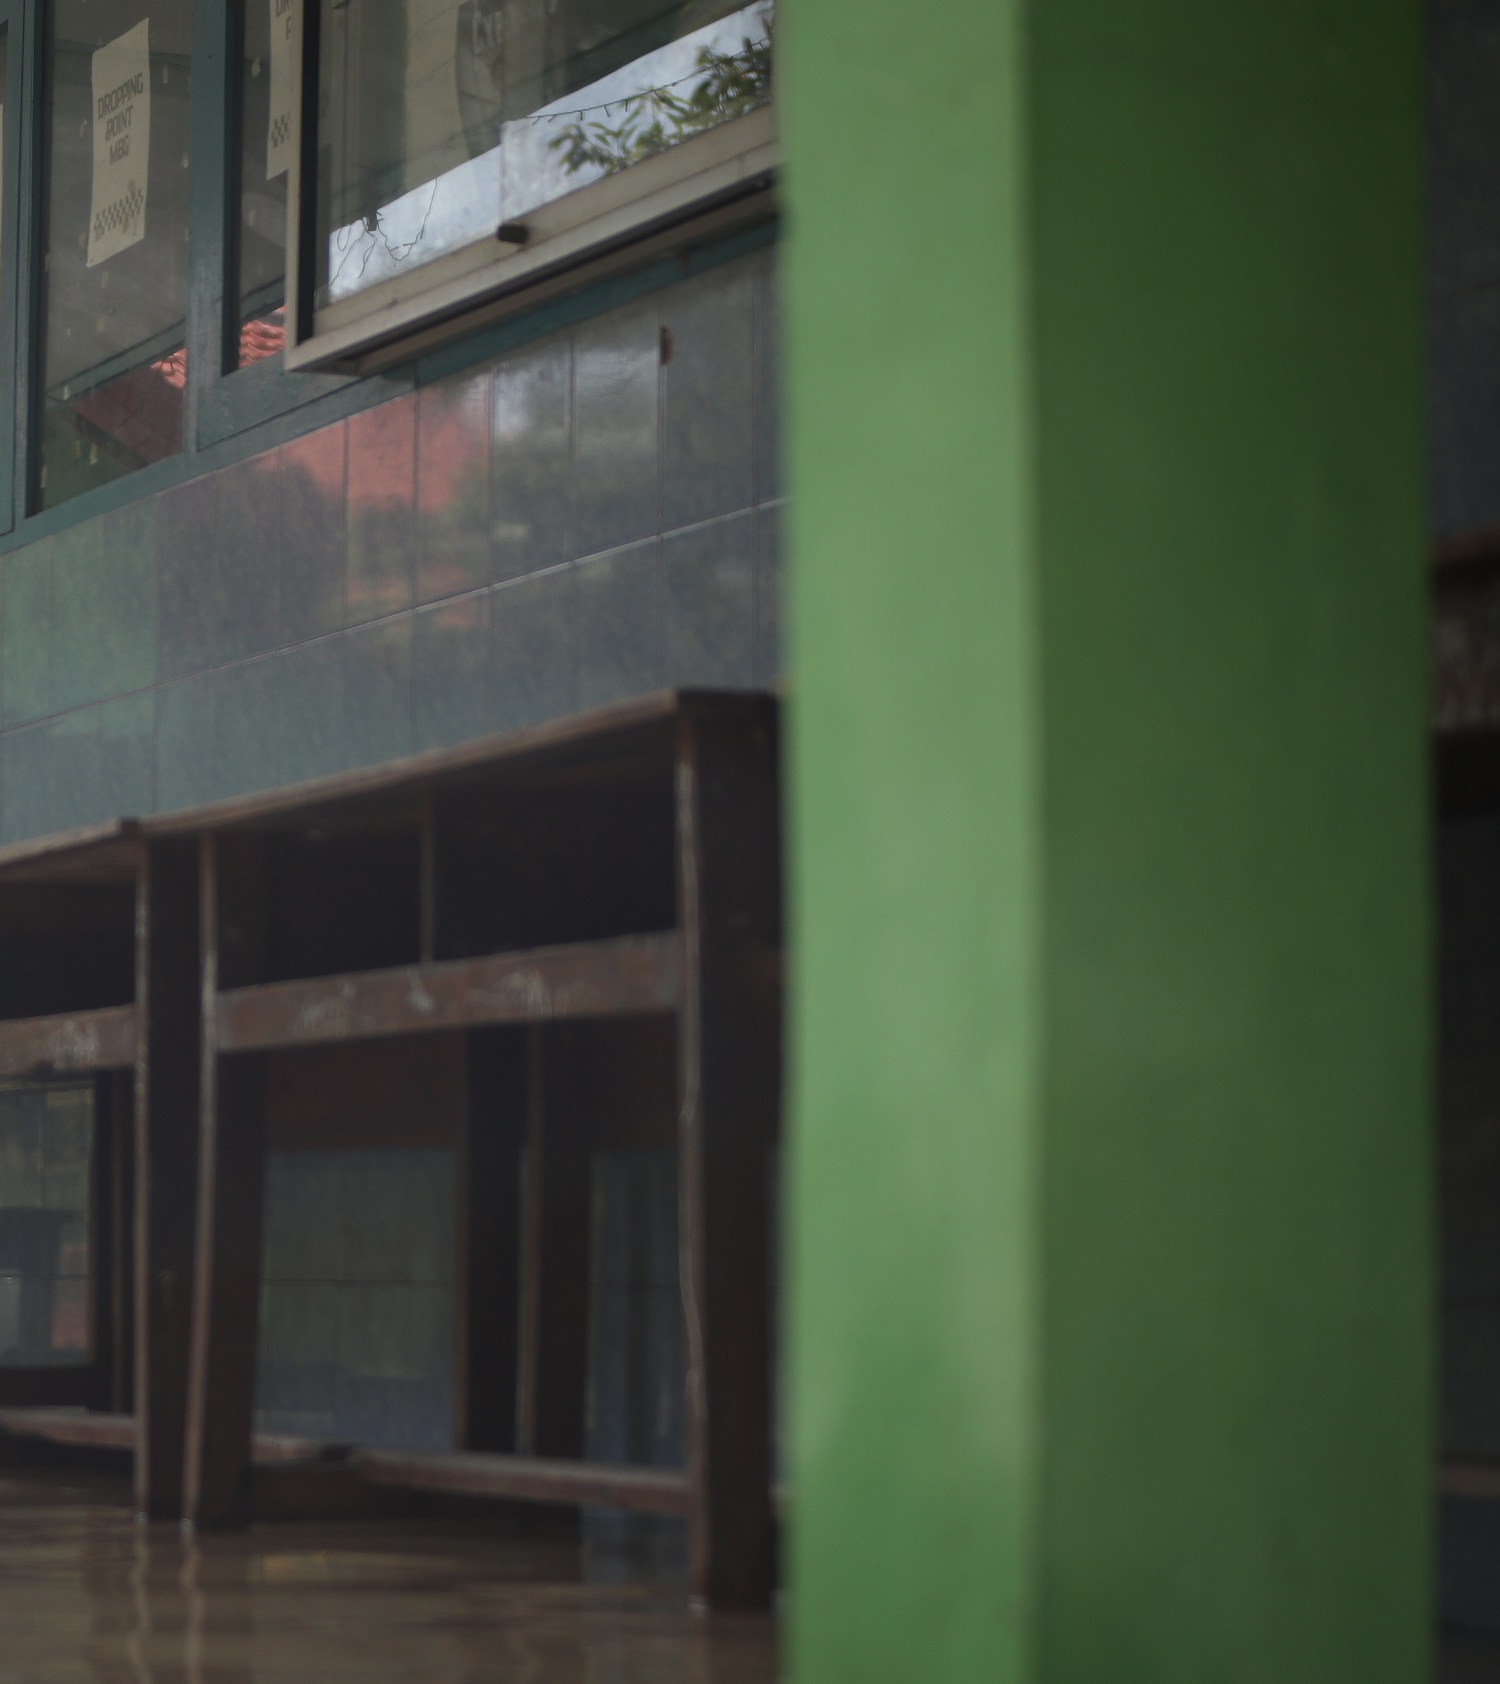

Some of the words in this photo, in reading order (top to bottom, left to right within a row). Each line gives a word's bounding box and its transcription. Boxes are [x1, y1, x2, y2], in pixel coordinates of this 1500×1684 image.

[97, 72, 144, 119] DROPPING
[105, 104, 133, 141] POINT
[109, 134, 130, 166] MBG
